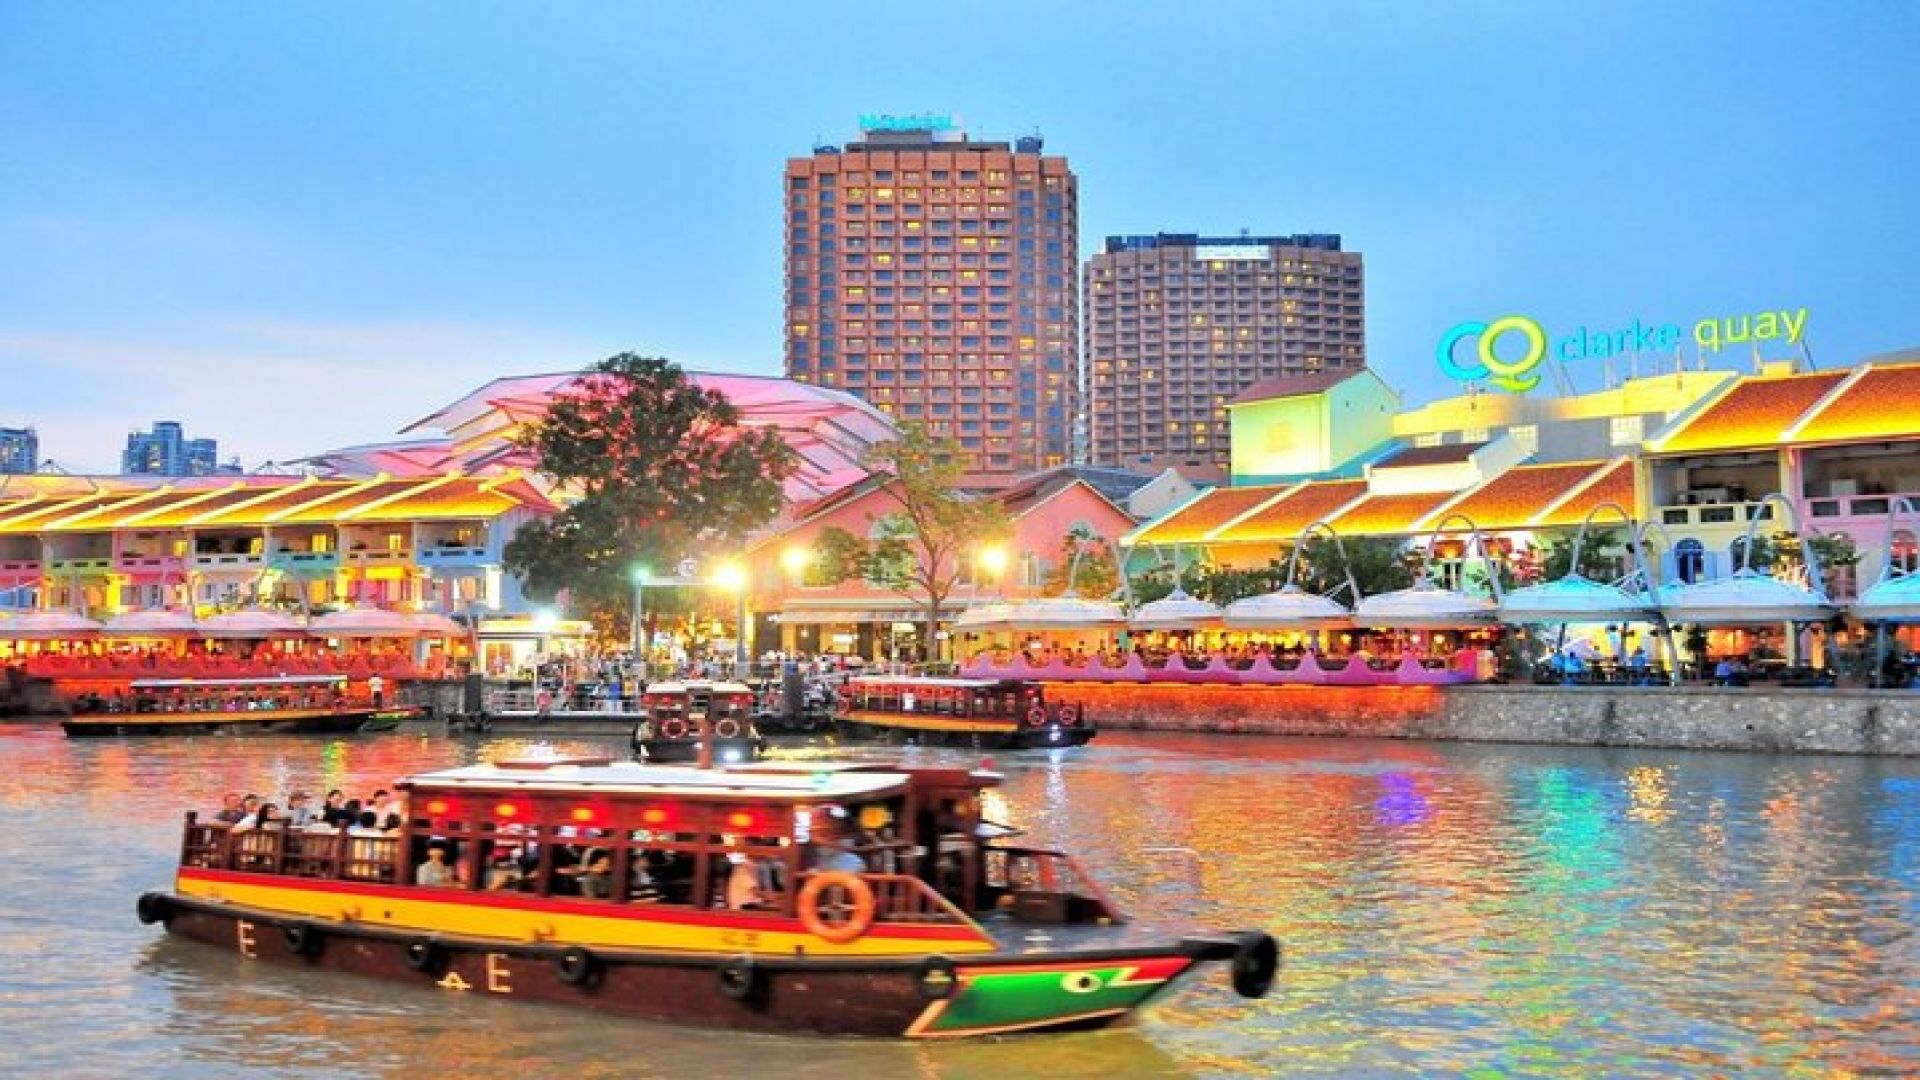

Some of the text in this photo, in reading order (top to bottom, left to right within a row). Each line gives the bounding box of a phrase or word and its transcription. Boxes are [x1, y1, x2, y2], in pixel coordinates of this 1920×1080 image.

[1436, 307, 1808, 392] CQ clarke quay
